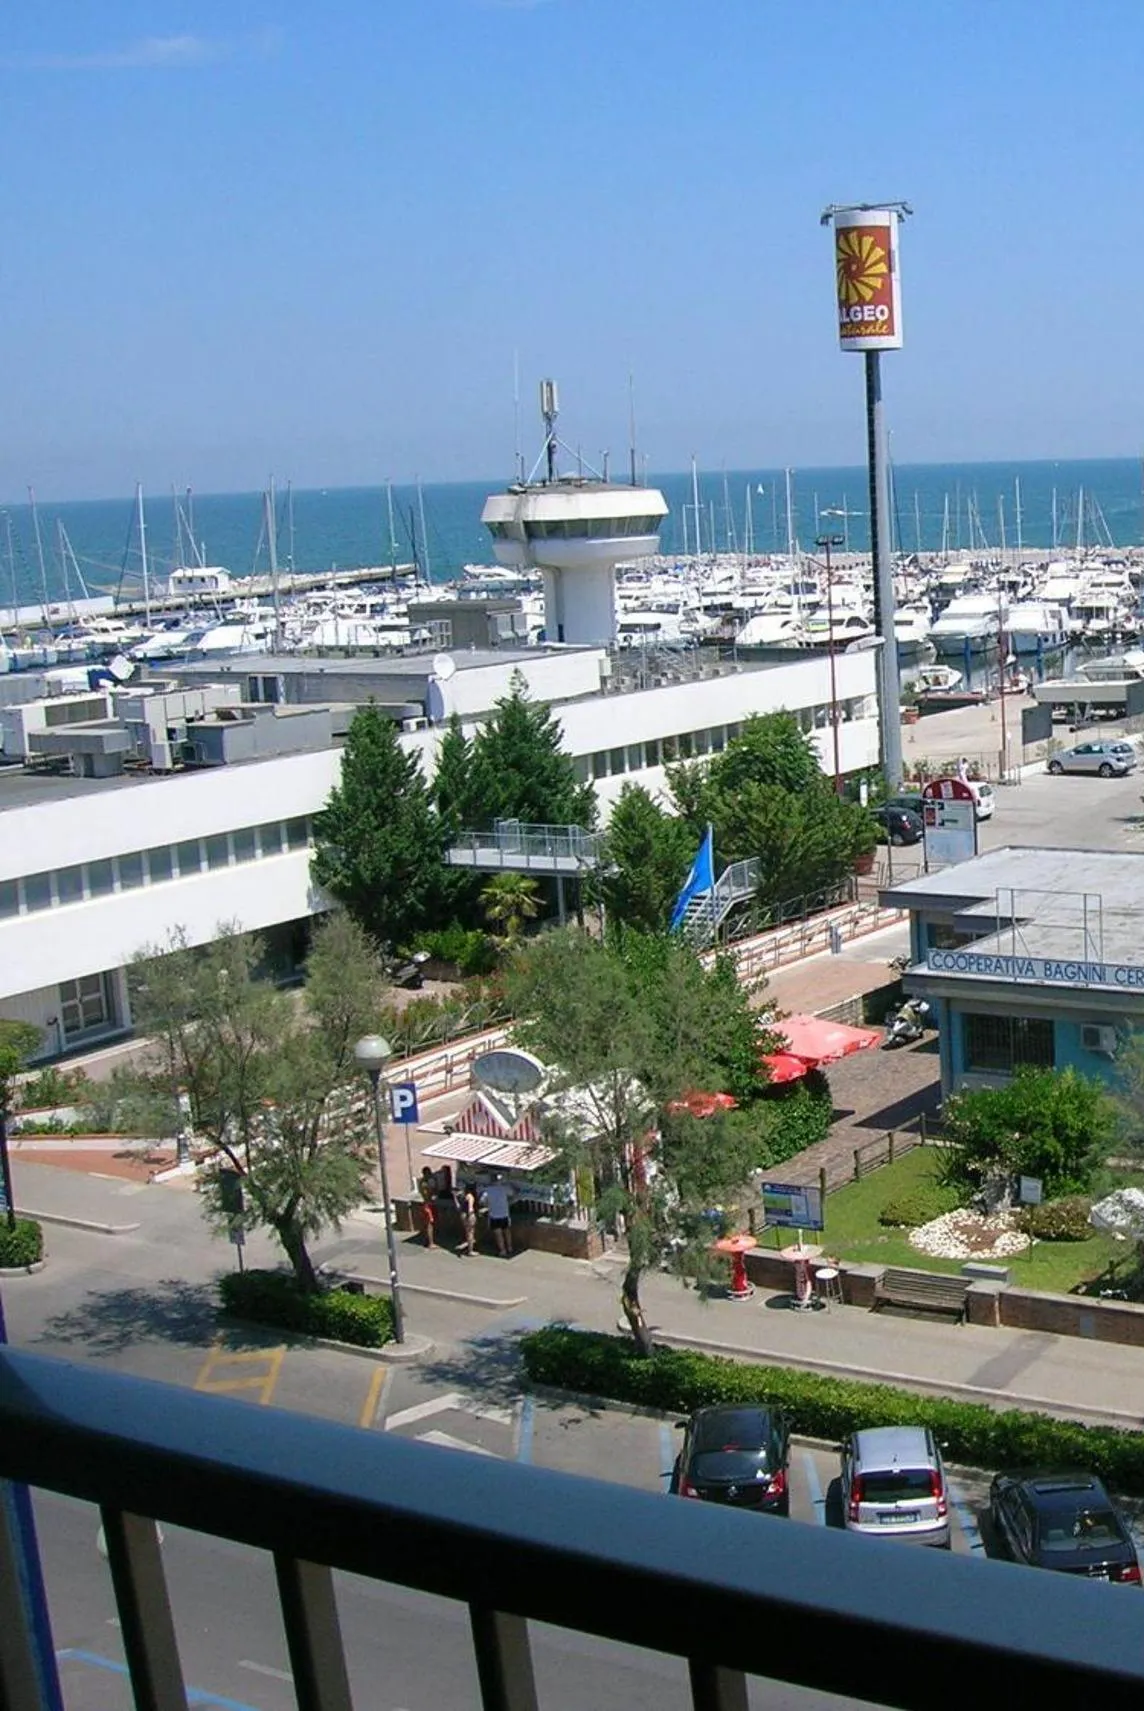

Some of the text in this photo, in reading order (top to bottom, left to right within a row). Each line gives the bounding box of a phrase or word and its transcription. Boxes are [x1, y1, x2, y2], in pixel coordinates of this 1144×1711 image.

[840, 304, 889, 322] LGEO
[931, 952, 1035, 977] COOPERATIVA
[1044, 963, 1107, 981] BAGNINI
[392, 1088, 414, 1118] P
